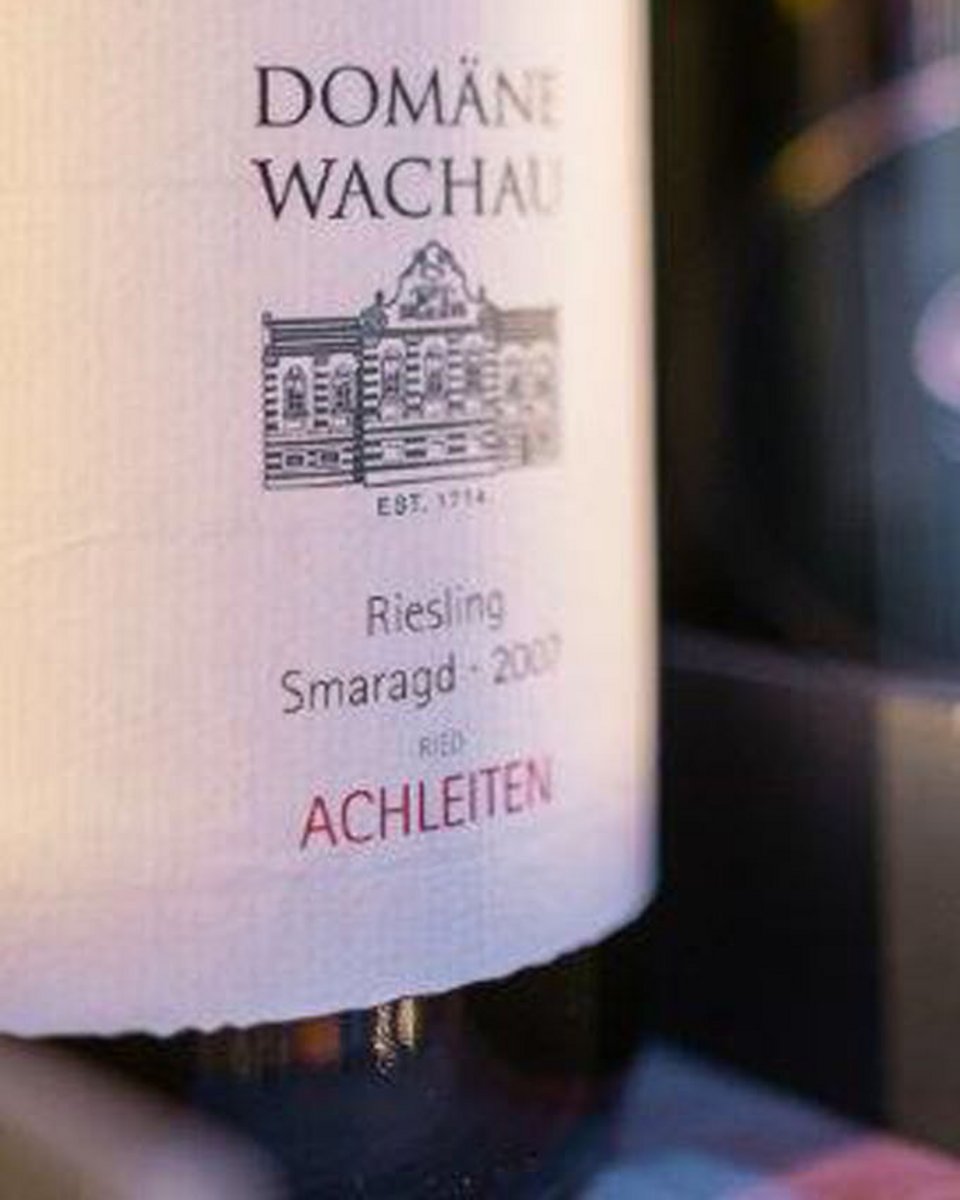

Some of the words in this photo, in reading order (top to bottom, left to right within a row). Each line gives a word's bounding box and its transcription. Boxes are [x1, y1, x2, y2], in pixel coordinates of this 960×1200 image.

[255, 54, 564, 129] DOMÄNE
[250, 154, 563, 222] WACHAU
[365, 584, 506, 636] Riesling
[280, 651, 457, 715] Smaragd
[418, 729, 465, 760] RIED
[300, 758, 554, 850] ACHLEITEN
